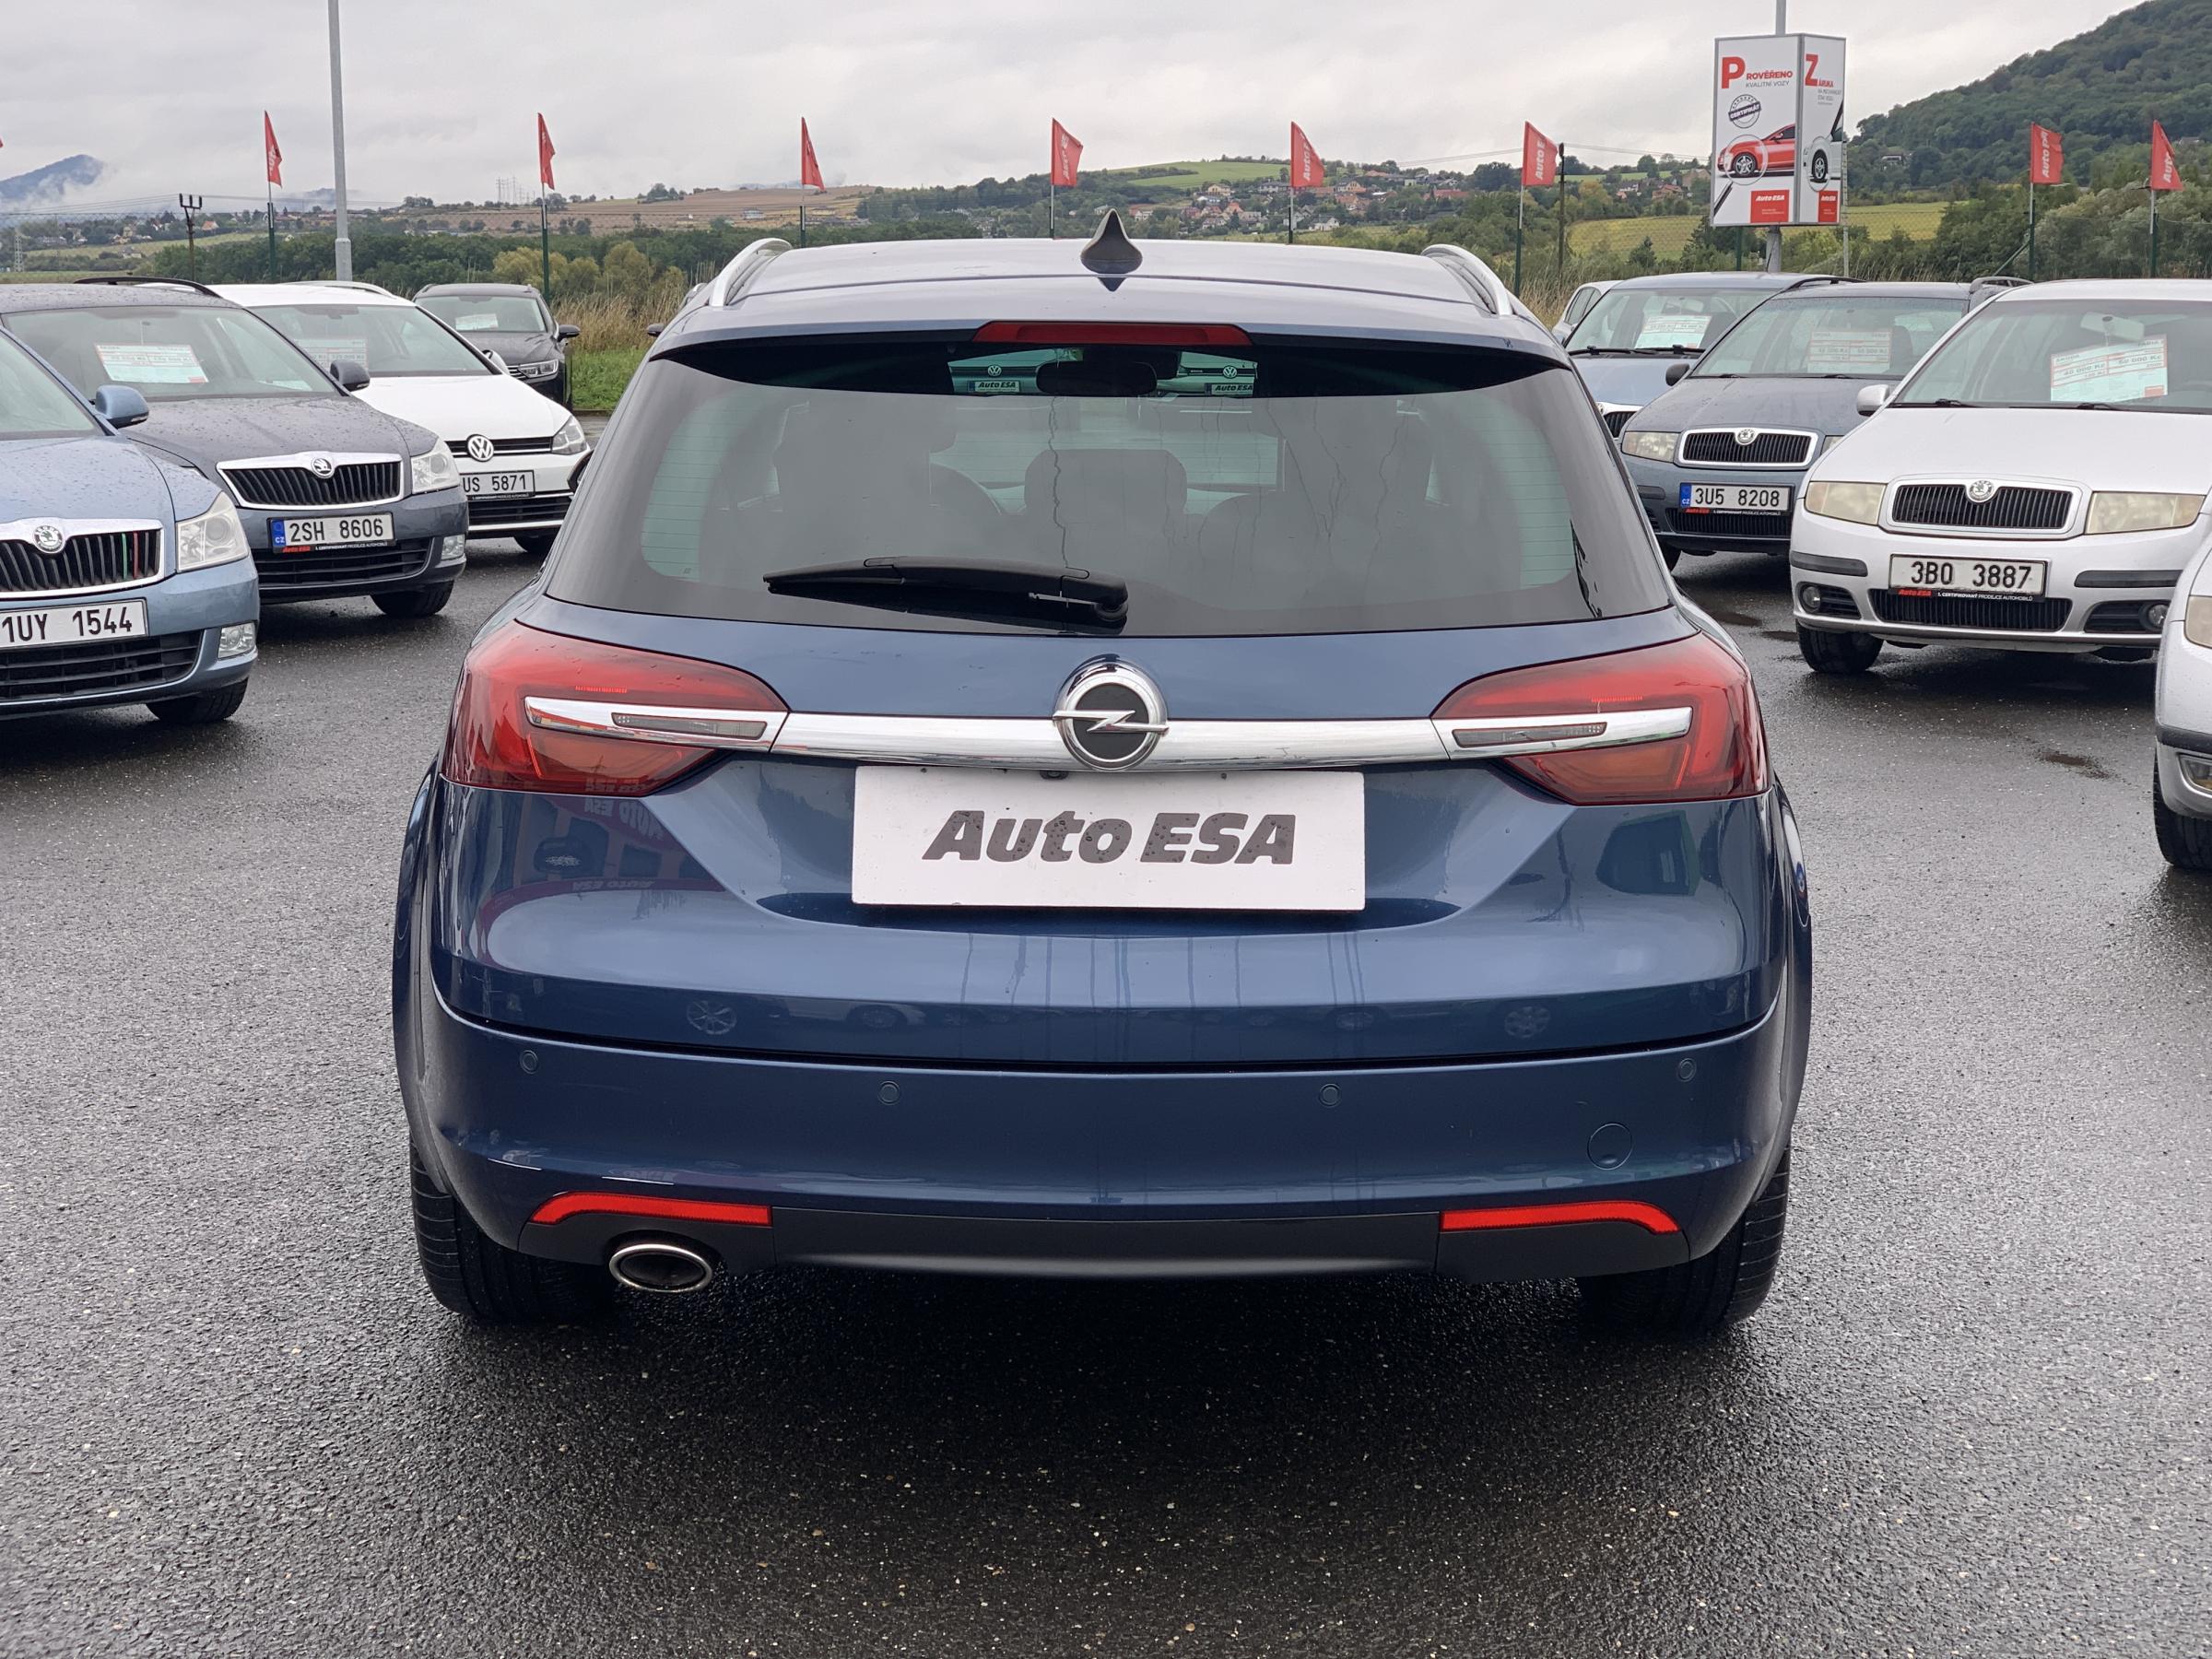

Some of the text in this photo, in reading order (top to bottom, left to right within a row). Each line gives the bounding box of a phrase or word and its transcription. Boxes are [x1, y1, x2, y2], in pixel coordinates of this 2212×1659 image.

[1535, 149, 1545, 181] Auto
[2041, 150, 2051, 178] Auto
[491, 474, 526, 491] 5871
[1695, 488, 1780, 507] 3U5 8208
[288, 518, 384, 543] 2SH 8606
[1911, 560, 2032, 589] 3B0 3887
[2, 606, 133, 643] 1UY 1544
[922, 809, 1297, 865] Auto ESA
